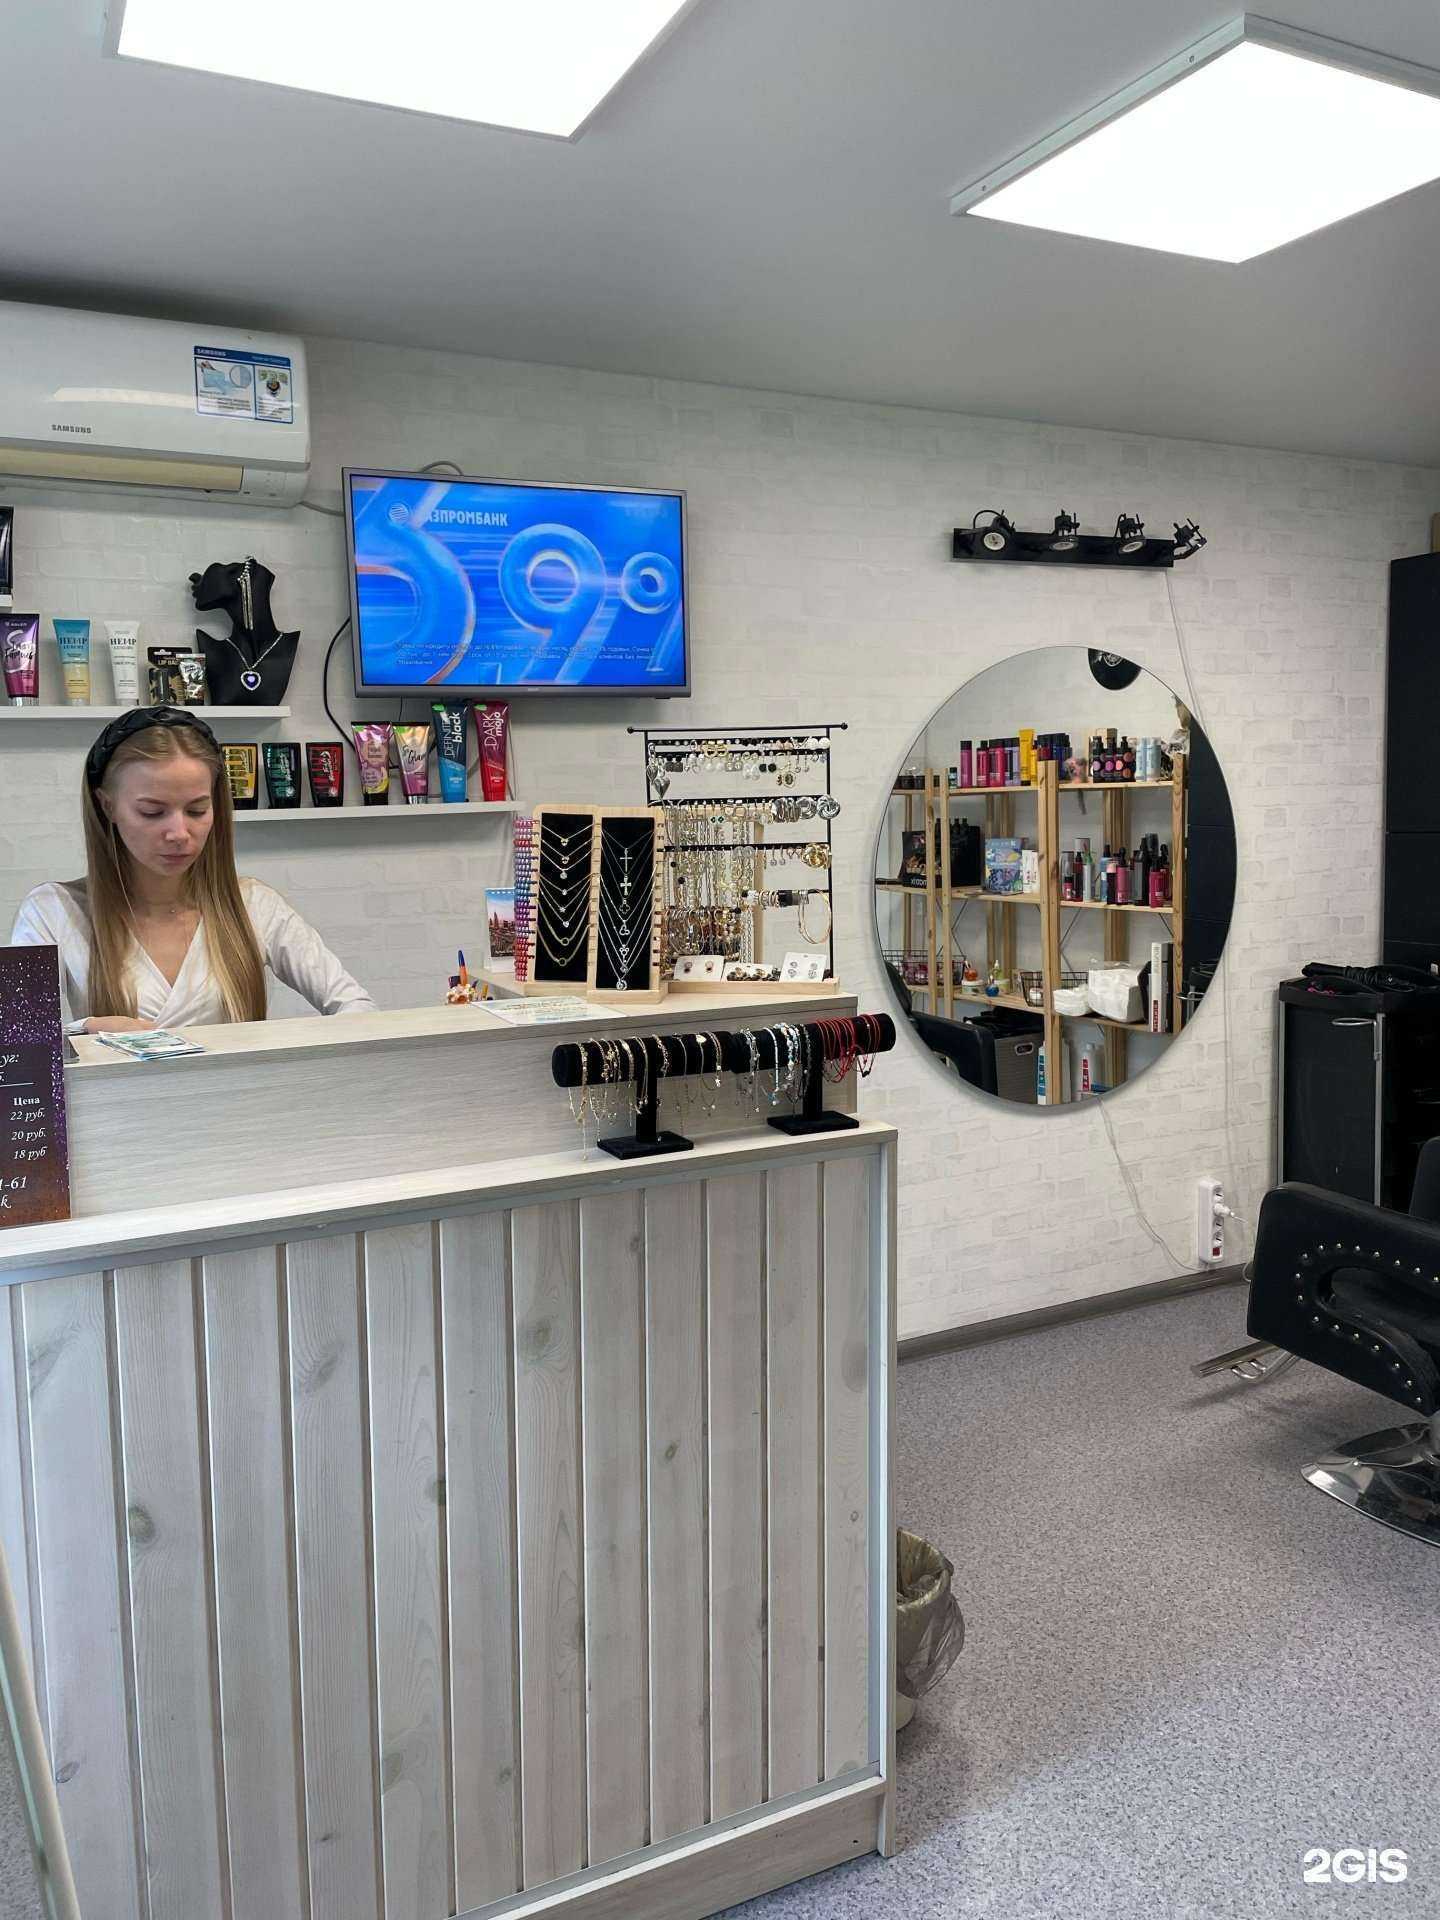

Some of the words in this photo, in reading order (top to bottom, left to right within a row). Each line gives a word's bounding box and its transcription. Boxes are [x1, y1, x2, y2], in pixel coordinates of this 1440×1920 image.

[51, 424, 92, 434] SAMSUNG
[59, 637, 88, 645] HEMP
[109, 638, 137, 646] HEMP
[449, 712, 463, 743] black
[482, 713, 497, 746] DARK
[493, 711, 504, 736] mojo
[13, 1096, 41, 1107] Цена
[10, 1111, 23, 1121] 22
[25, 1108, 46, 1122] руб.
[11, 1131, 24, 1140] 20
[26, 1128, 47, 1142] руб.
[14, 1149, 26, 1159] 18
[27, 1147, 48, 1161] руб
